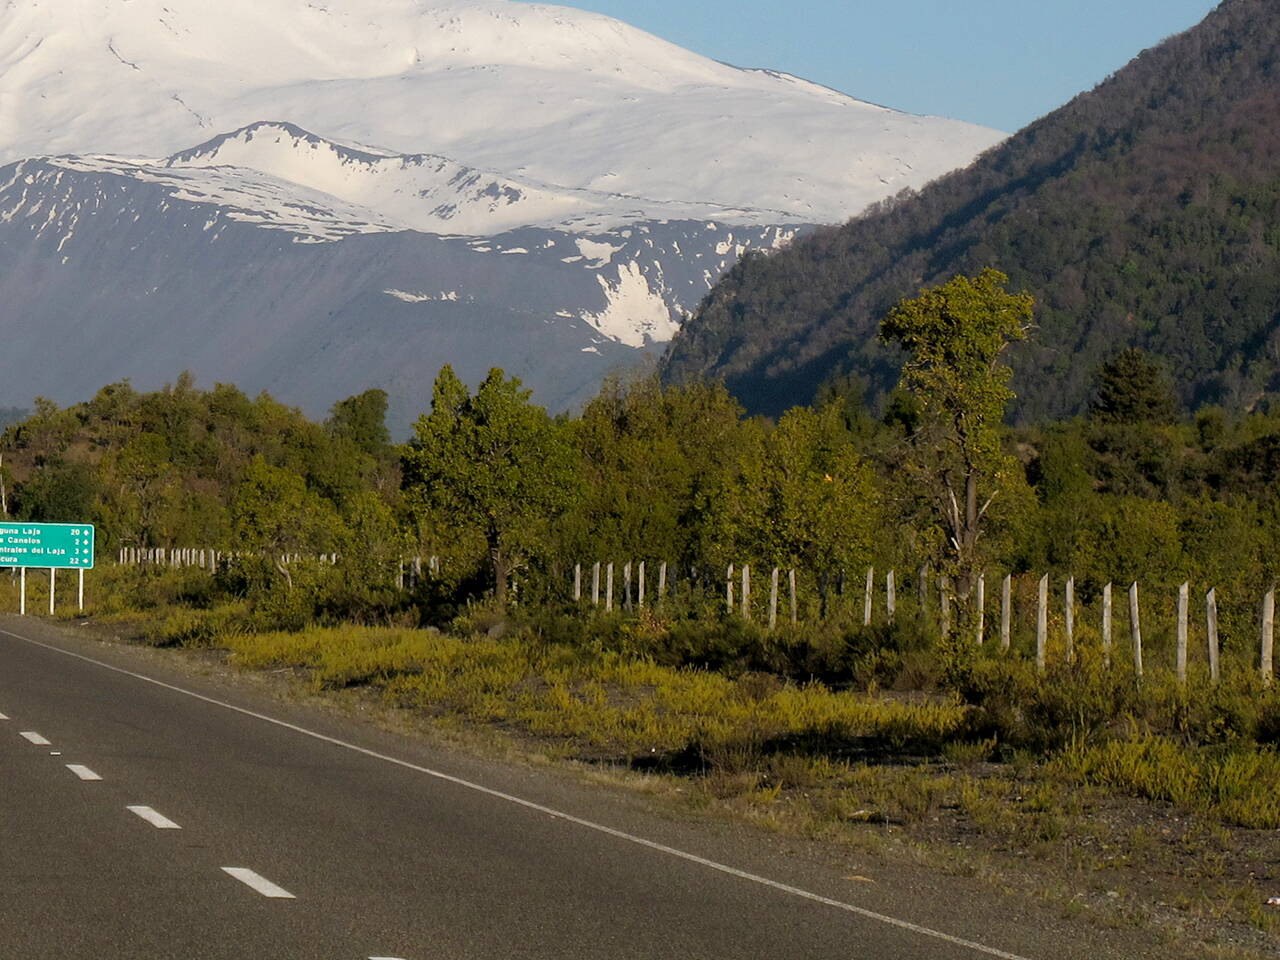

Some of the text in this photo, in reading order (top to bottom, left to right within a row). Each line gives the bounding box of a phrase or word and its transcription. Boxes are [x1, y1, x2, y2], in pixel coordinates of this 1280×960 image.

[22, 528, 41, 536] Laja
[7, 536, 41, 544] Canelos
[46, 547, 66, 555] Laja
